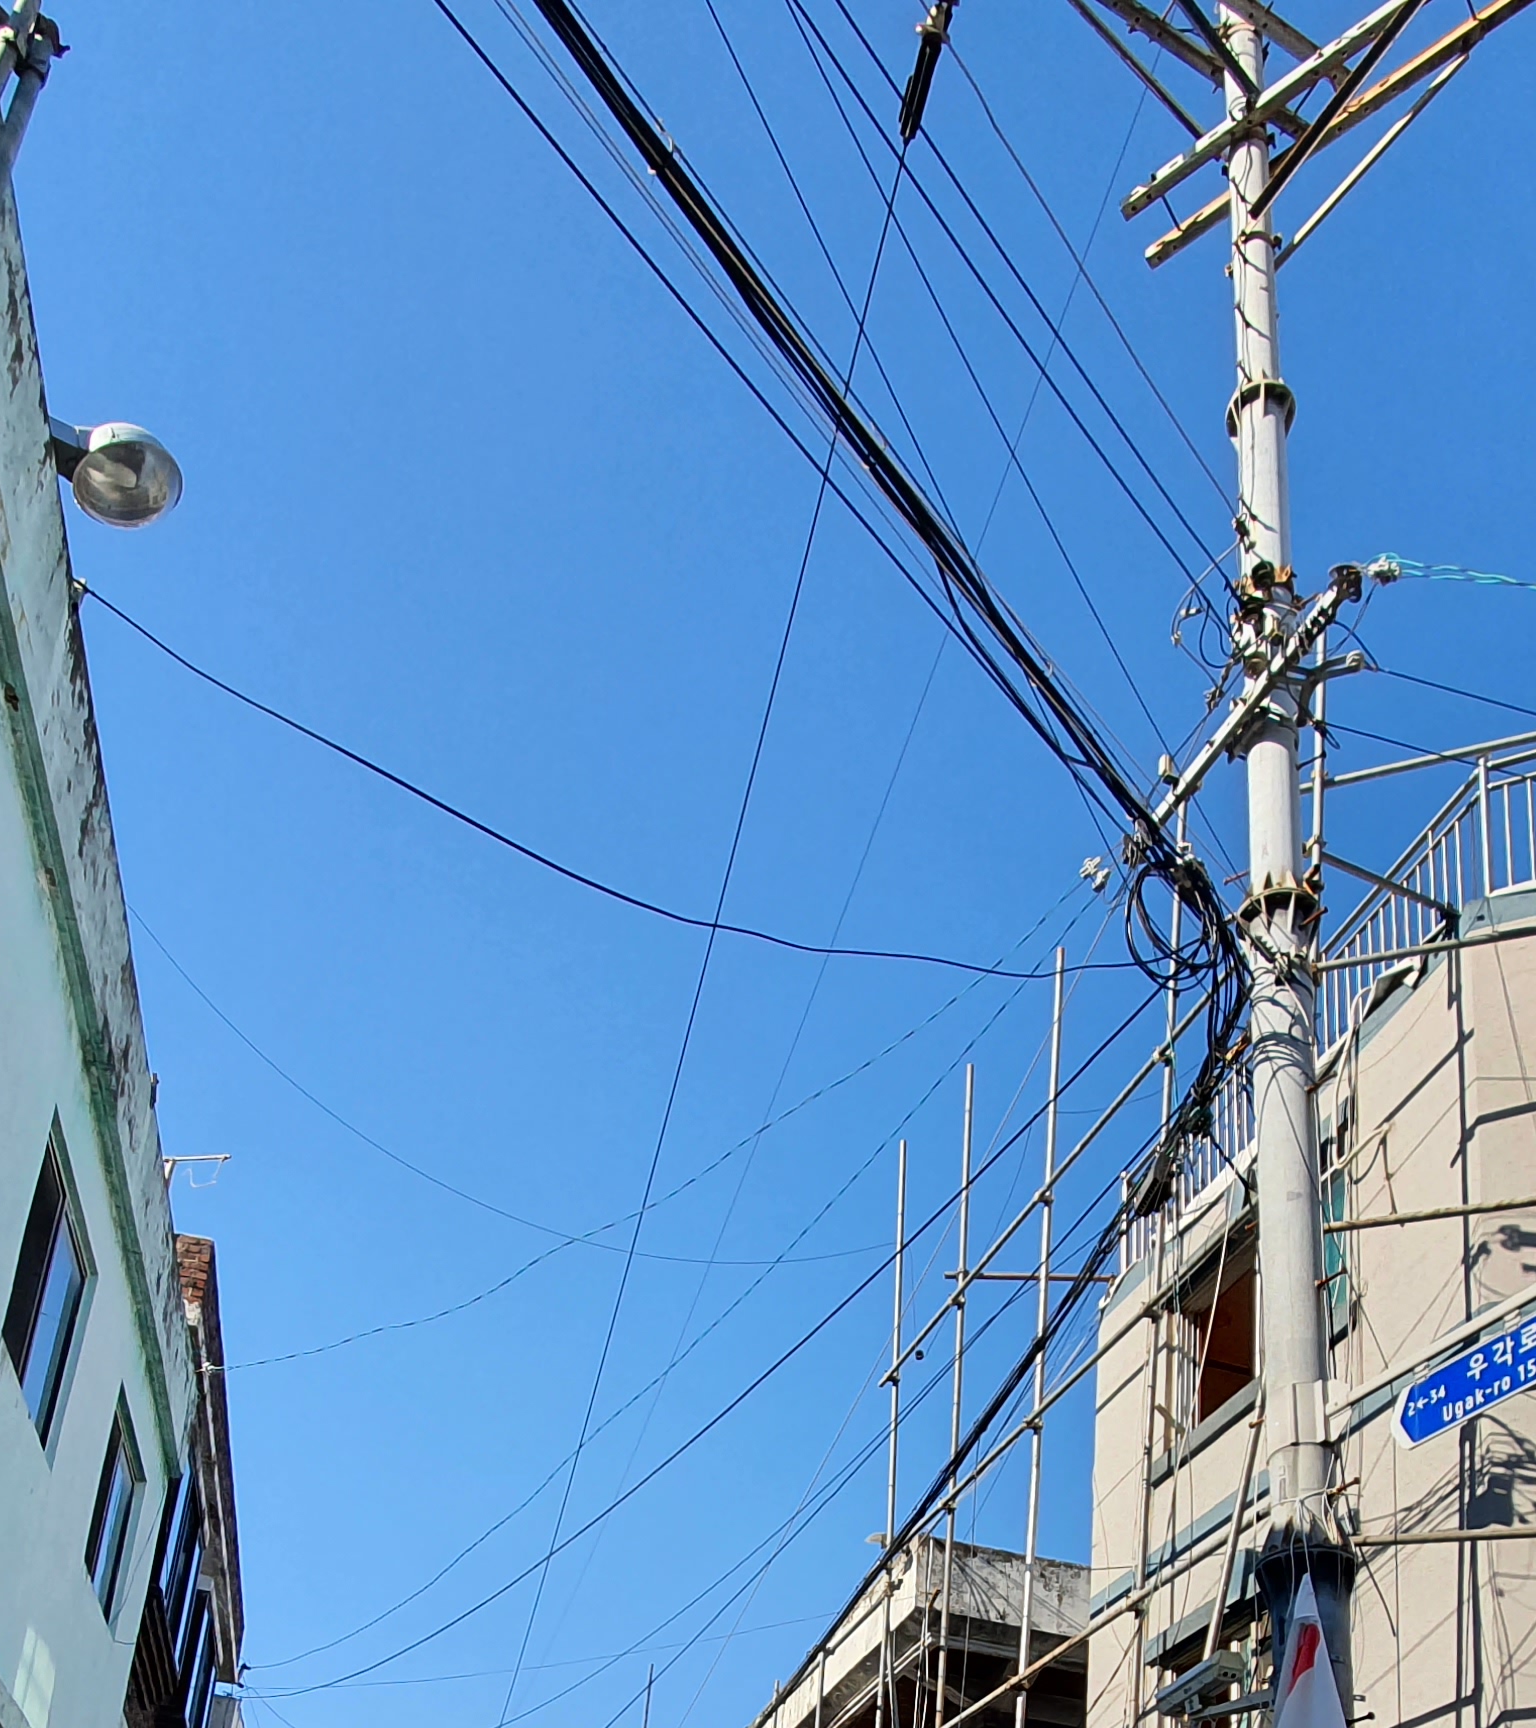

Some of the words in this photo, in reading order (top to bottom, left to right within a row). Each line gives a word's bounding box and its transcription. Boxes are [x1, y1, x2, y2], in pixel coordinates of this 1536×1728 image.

[1407, 1402, 1417, 1417] 2
[1429, 1384, 1446, 1405] 34
[1442, 1375, 1512, 1422] Ugak-ro
